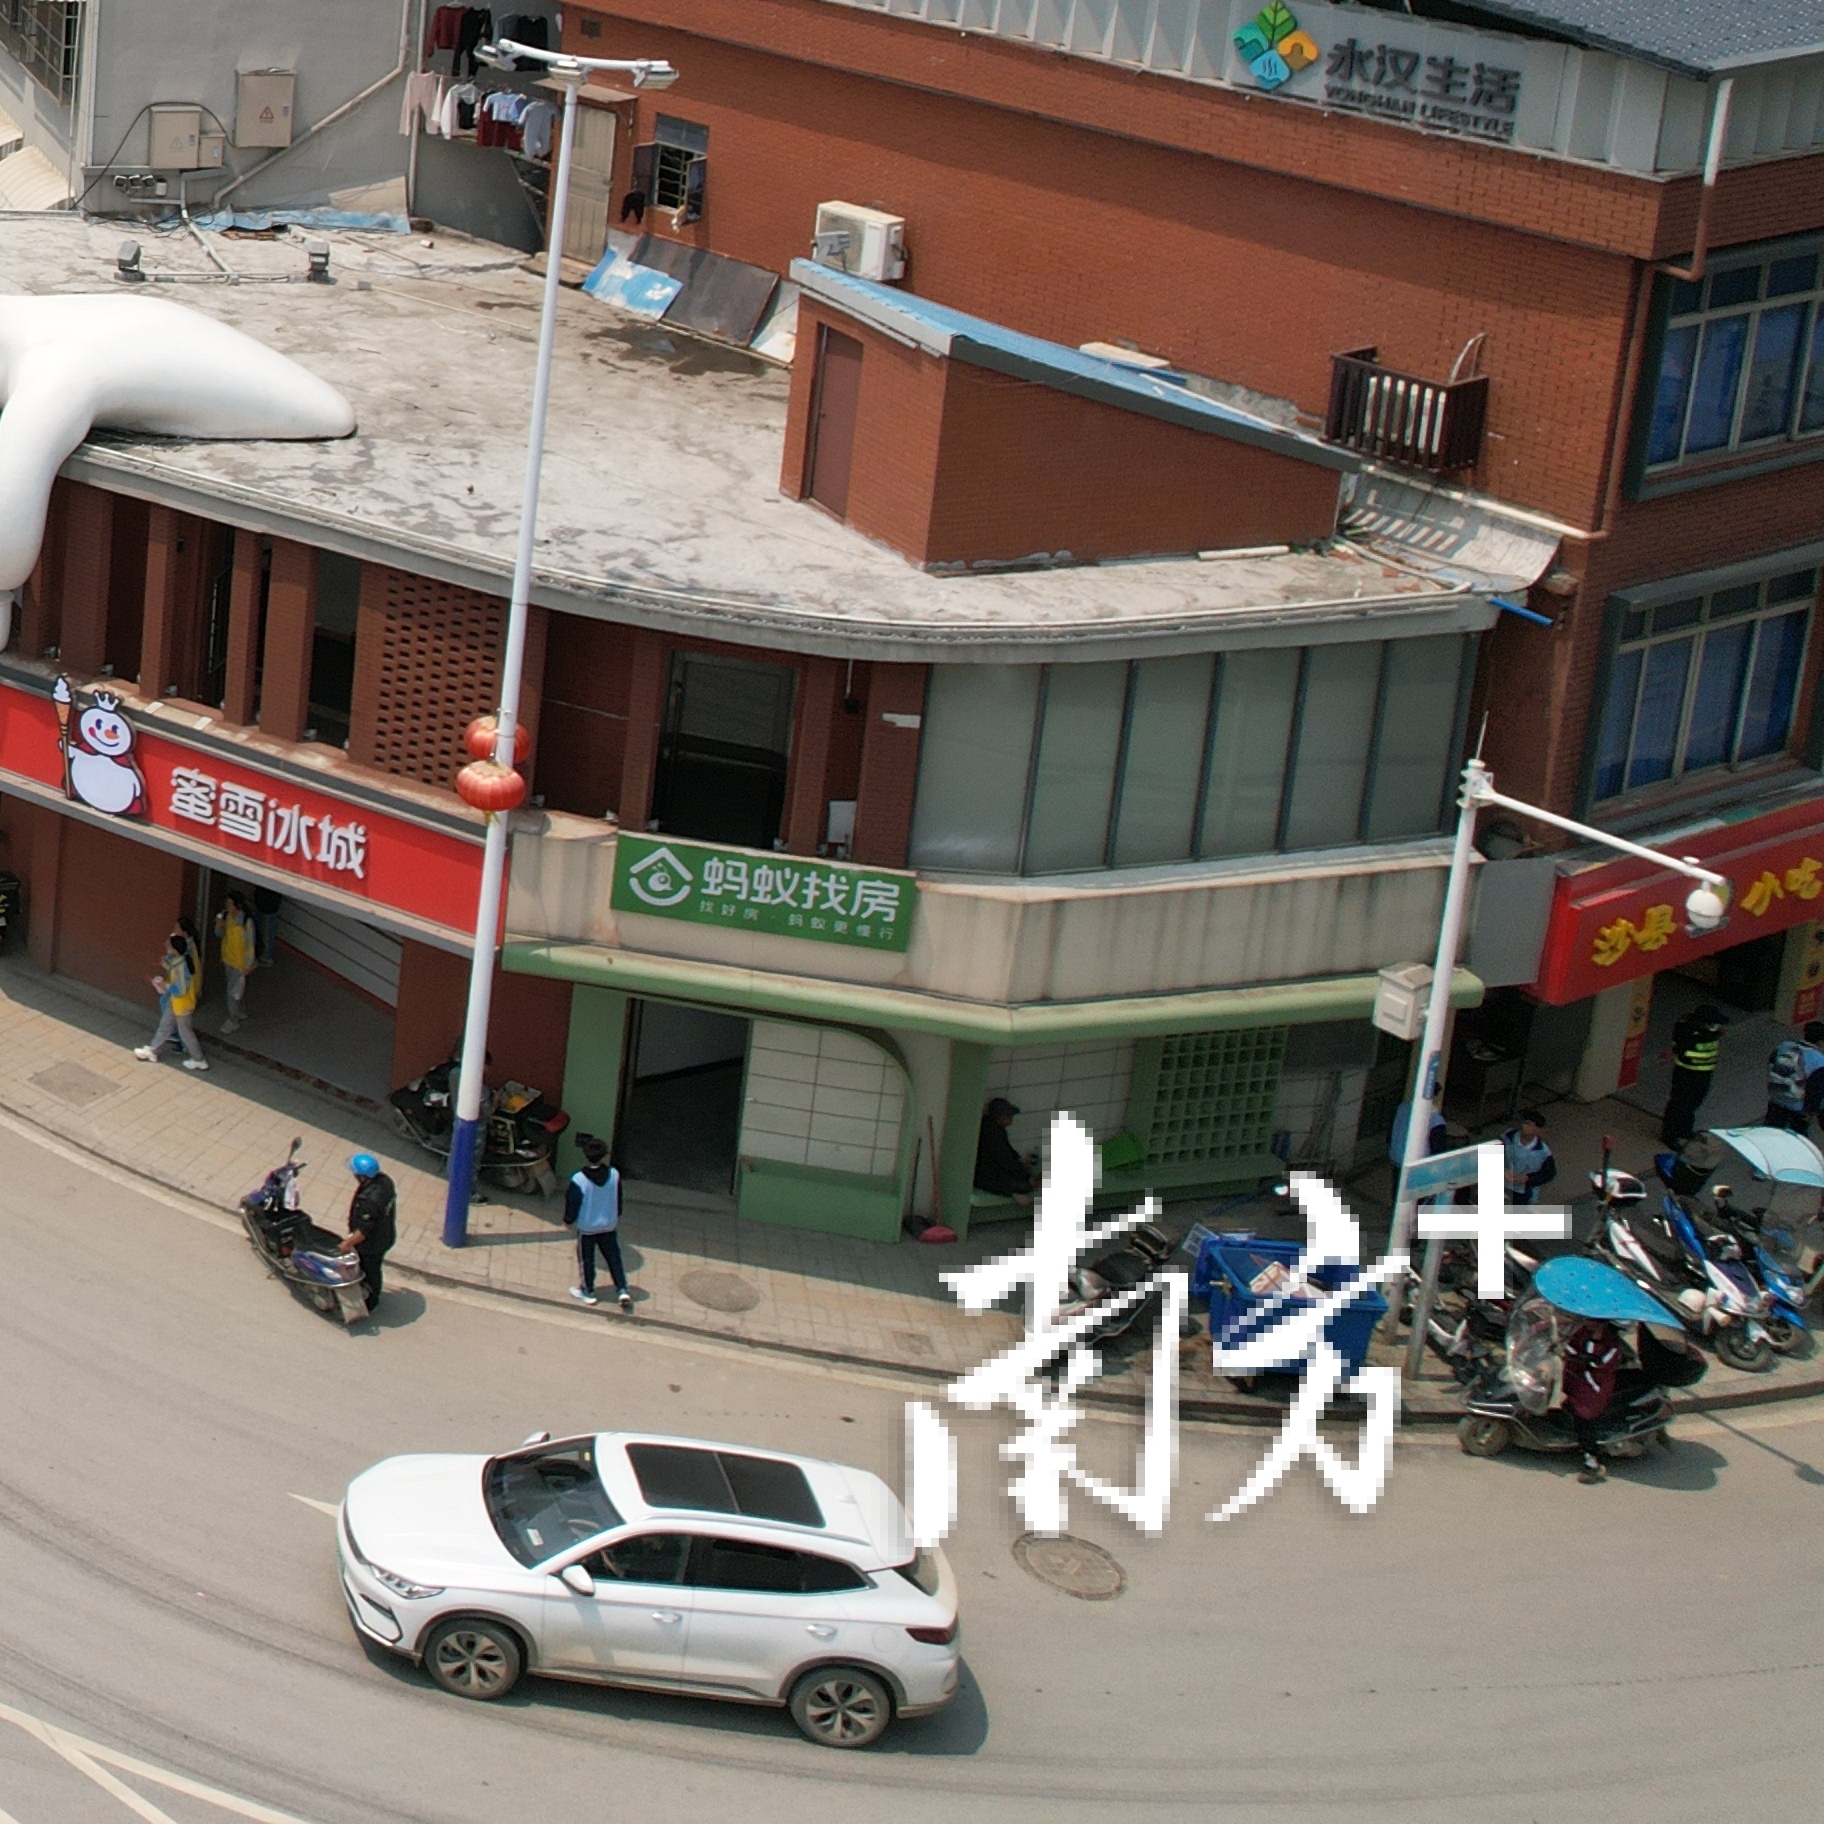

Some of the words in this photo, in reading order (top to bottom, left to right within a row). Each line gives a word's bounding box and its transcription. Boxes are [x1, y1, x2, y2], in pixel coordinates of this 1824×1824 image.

[1324, 84, 1416, 115] YONGHAN
[1419, 104, 1515, 137] LIFESTYLE
[1325, 38, 1522, 114] 永汉生活
[169, 765, 367, 880] 蜜雪冰城
[700, 856, 900, 923] 蚂蚁找房
[1591, 903, 1677, 966] 沙县
[1739, 857, 1824, 917] 小吃
